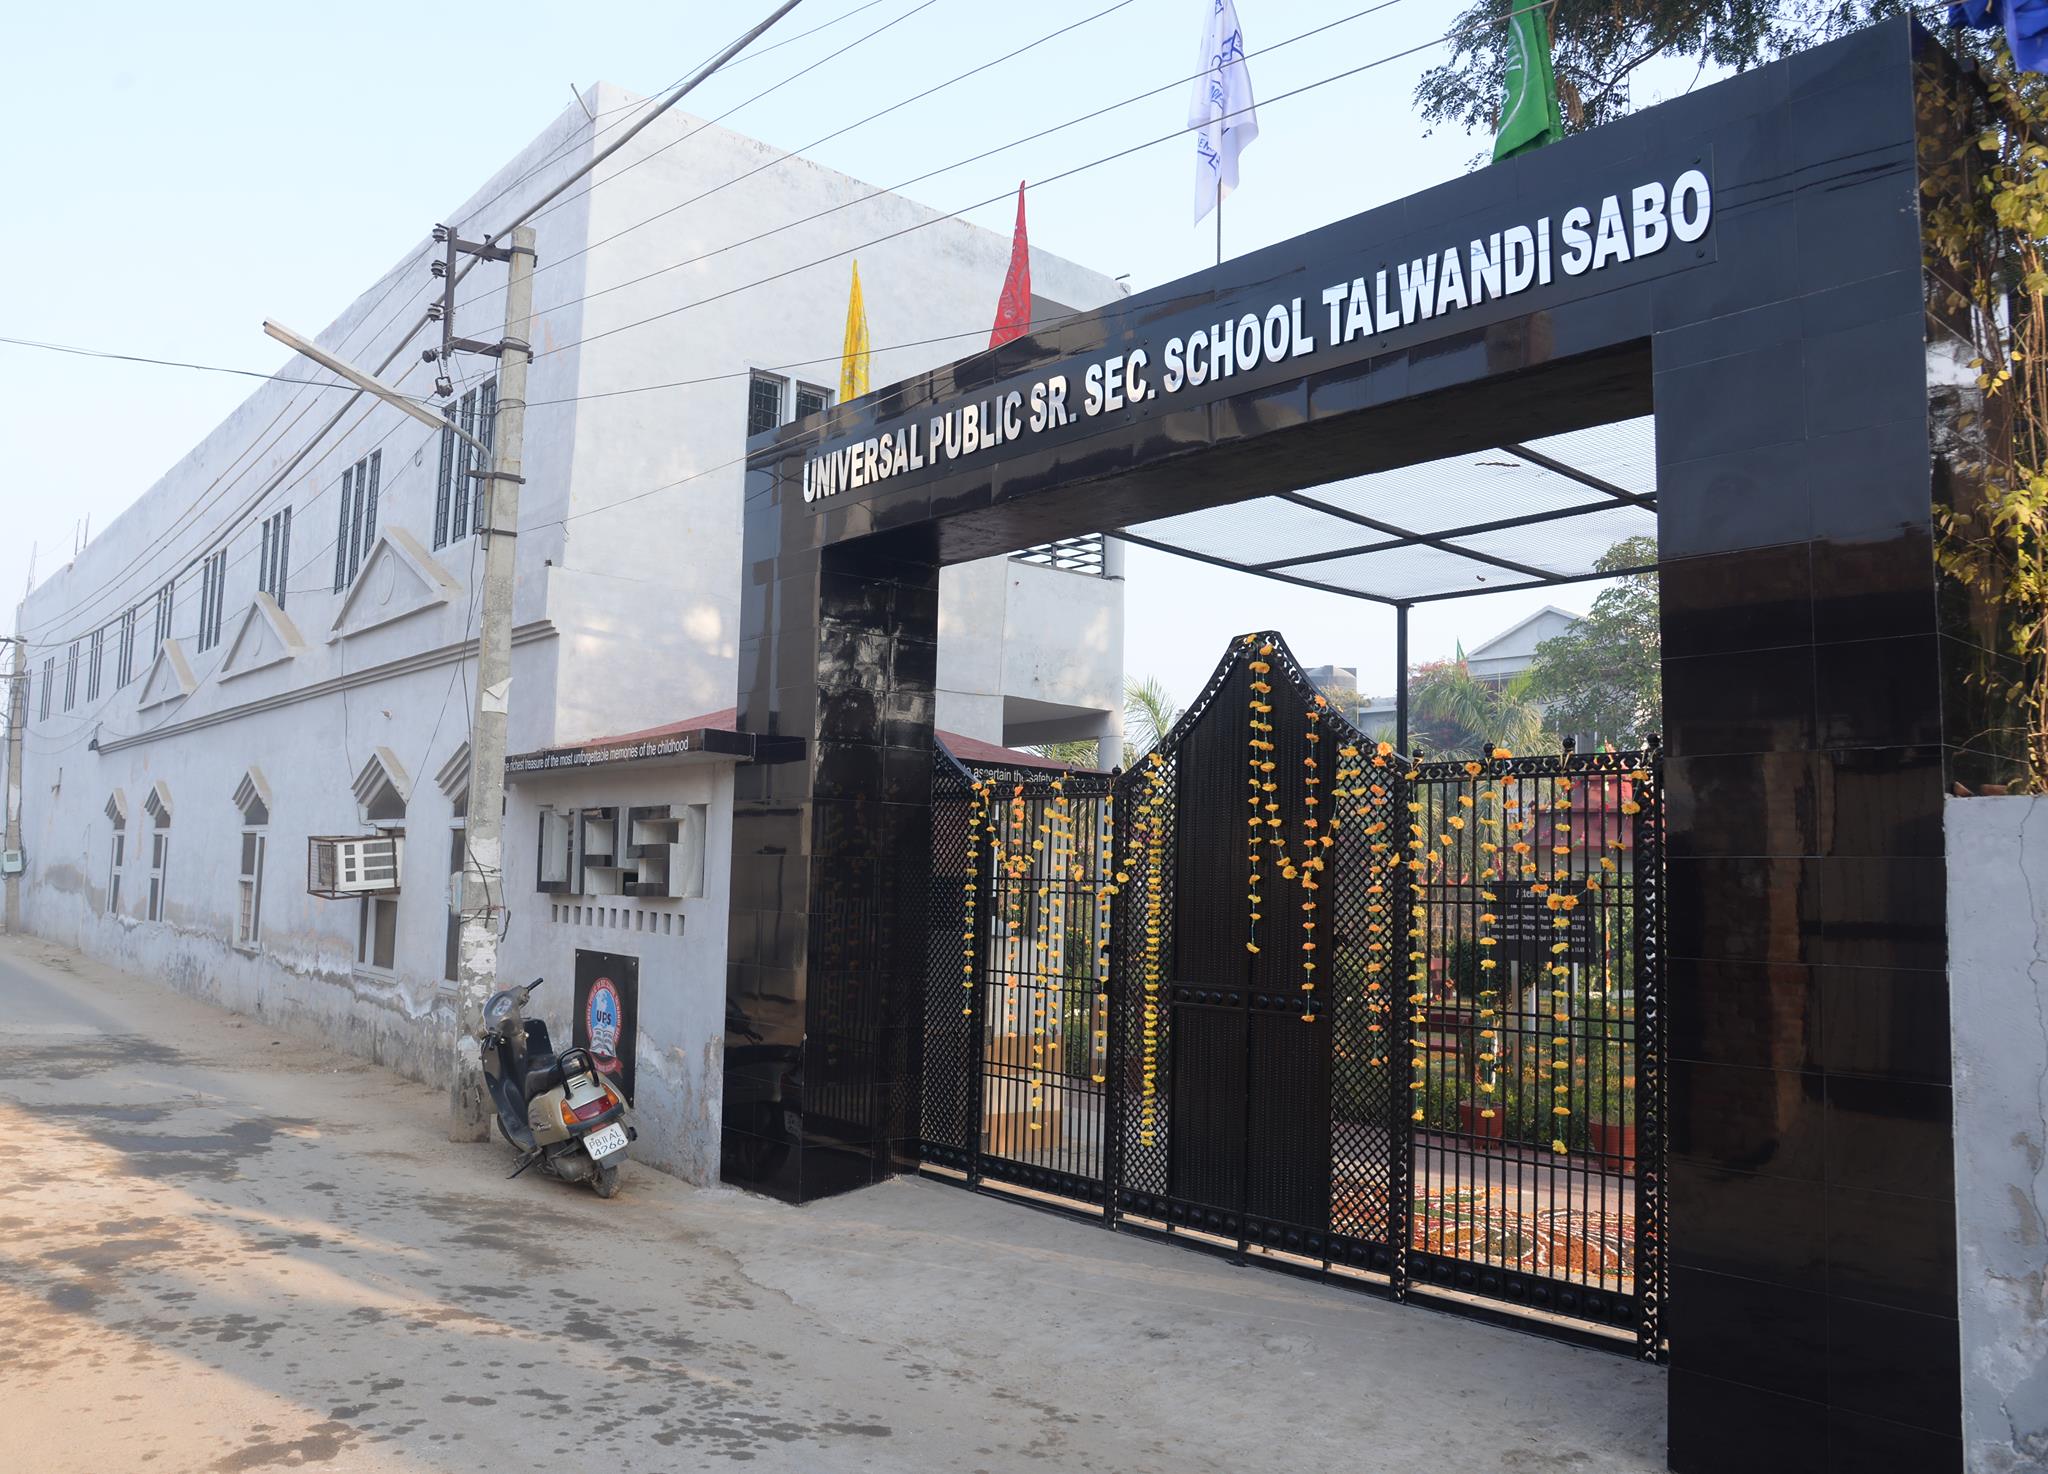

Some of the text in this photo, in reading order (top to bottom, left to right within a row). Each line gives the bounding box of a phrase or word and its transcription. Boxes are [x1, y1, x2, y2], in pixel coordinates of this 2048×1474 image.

[803, 169, 1712, 503] UNIVERSAL PUBLIC SR. SEC. SCHOOL TALWANDI SABO
[525, 758, 544, 770] treasure
[550, 754, 559, 767] the
[560, 752, 573, 766] most
[574, 747, 609, 766] unforgettable
[609, 744, 639, 760] memories
[639, 742, 647, 757] of
[646, 741, 657, 756] the
[657, 735, 689, 755] childhood
[973, 767, 1012, 782] ascertain
[536, 804, 681, 898] UPS
[596, 1009, 612, 1026] UPS
